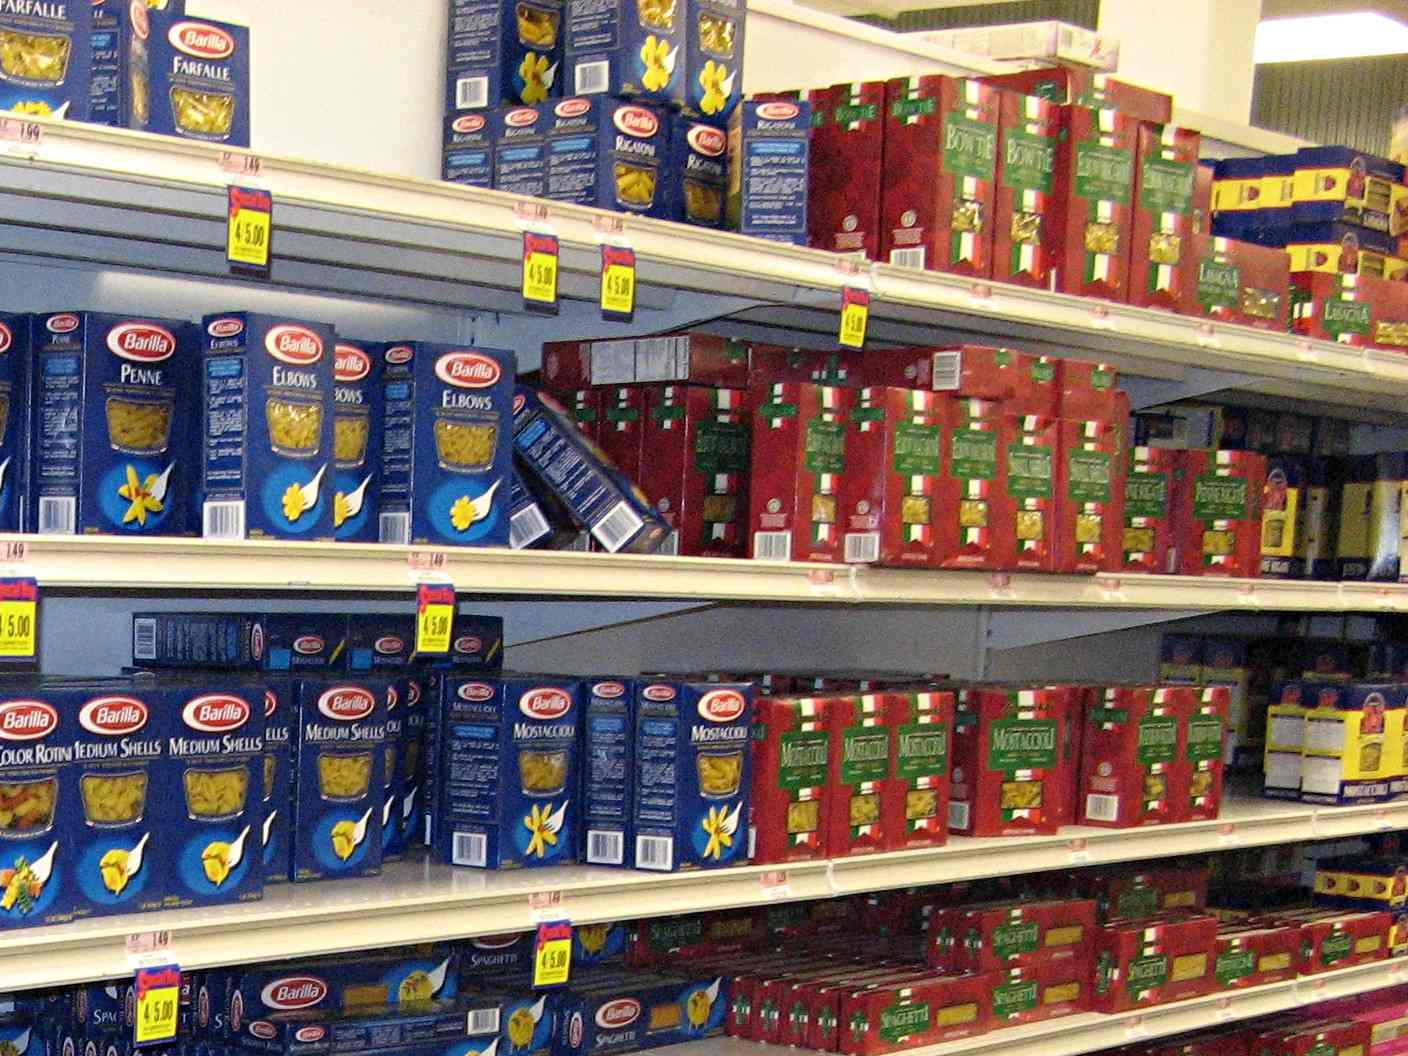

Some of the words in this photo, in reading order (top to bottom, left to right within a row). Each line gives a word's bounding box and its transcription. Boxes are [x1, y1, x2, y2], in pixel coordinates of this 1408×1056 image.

[185, 33, 228, 53] Barilla
[173, 56, 230, 79] FARFALLE
[123, 333, 168, 353] Barilla
[279, 332, 317, 356] Barilla
[120, 364, 162, 385] PENNE
[273, 366, 317, 388] ELBOWS
[451, 360, 494, 381] Barilla
[442, 388, 492, 411] ELBOWS
[199, 705, 244, 722] Barilla
[332, 695, 370, 712] Barilla
[5, 710, 50, 729] Barilla
[96, 707, 141, 725] Barilla
[305, 724, 349, 741] MEDIUM
[350, 724, 385, 741] SHELLS
[514, 724, 575, 739] MOSTACCIOLI
[35, 742, 72, 763] ROTINI
[169, 738, 219, 755] MEDIUM
[221, 736, 263, 753] SHELLS
[277, 983, 321, 1000] Barilla
